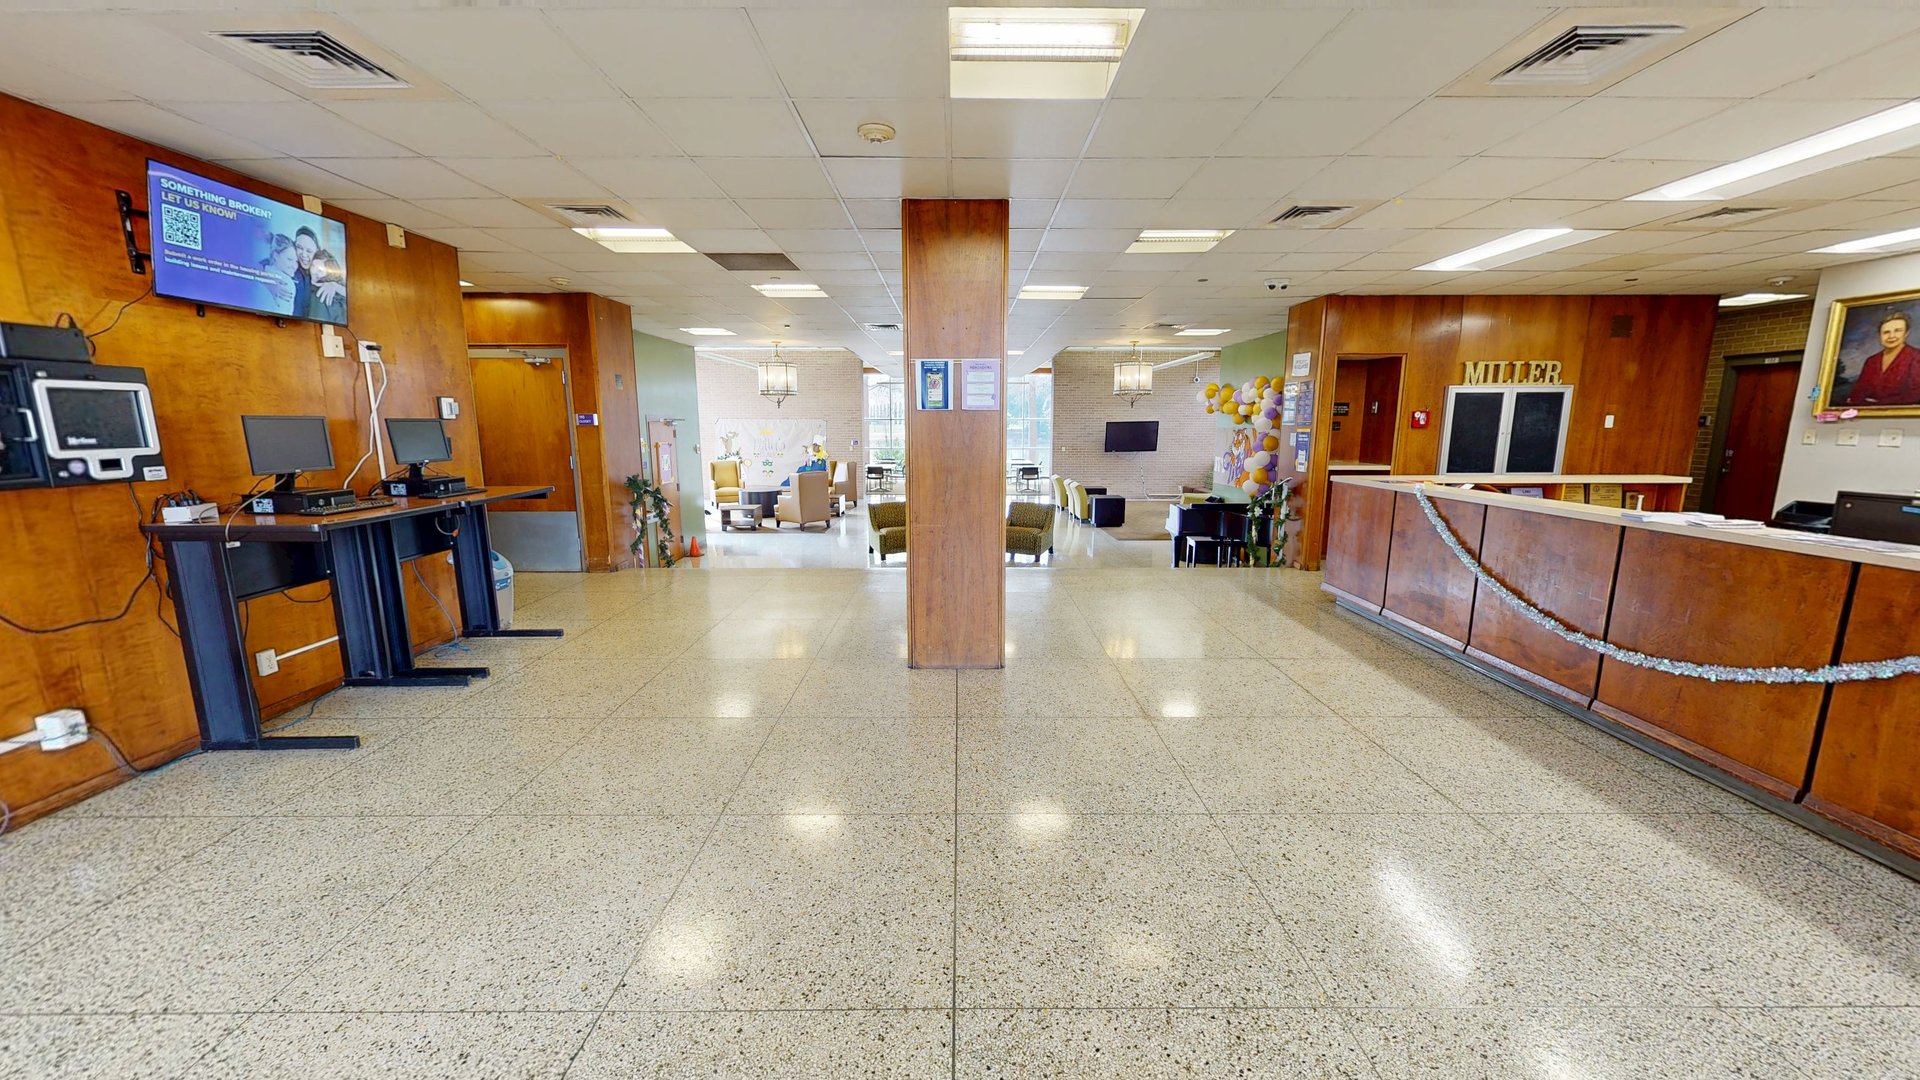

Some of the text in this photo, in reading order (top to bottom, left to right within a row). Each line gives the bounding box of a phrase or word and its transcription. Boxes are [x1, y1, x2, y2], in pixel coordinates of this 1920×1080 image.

[160, 178, 273, 219] SOMETHING BROKEN?
[161, 191, 237, 220] LET US KNOW!
[209, 265, 221, 273] and
[1463, 360, 1562, 386] MILLER
